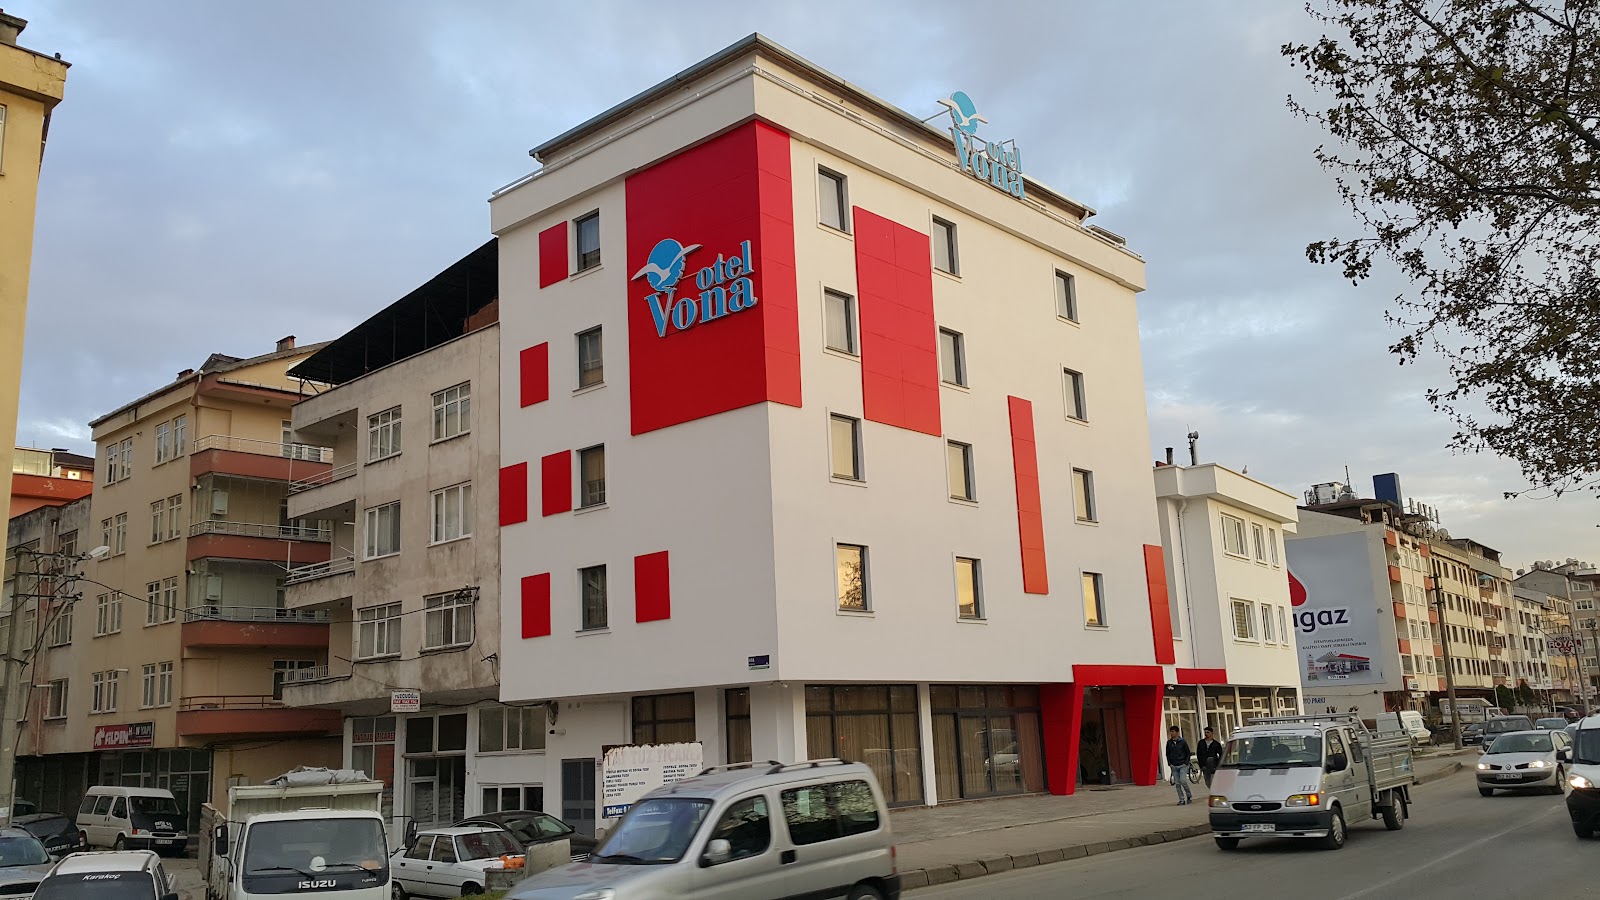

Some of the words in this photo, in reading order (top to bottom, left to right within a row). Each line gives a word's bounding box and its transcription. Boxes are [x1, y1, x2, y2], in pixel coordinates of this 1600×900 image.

[948, 127, 1027, 200] Vona
[985, 141, 1023, 176] otel
[695, 239, 755, 290] otel
[643, 276, 759, 338] Vona
[82, 873, 121, 881] Karakoç
[298, 879, 337, 889] ISUZU
